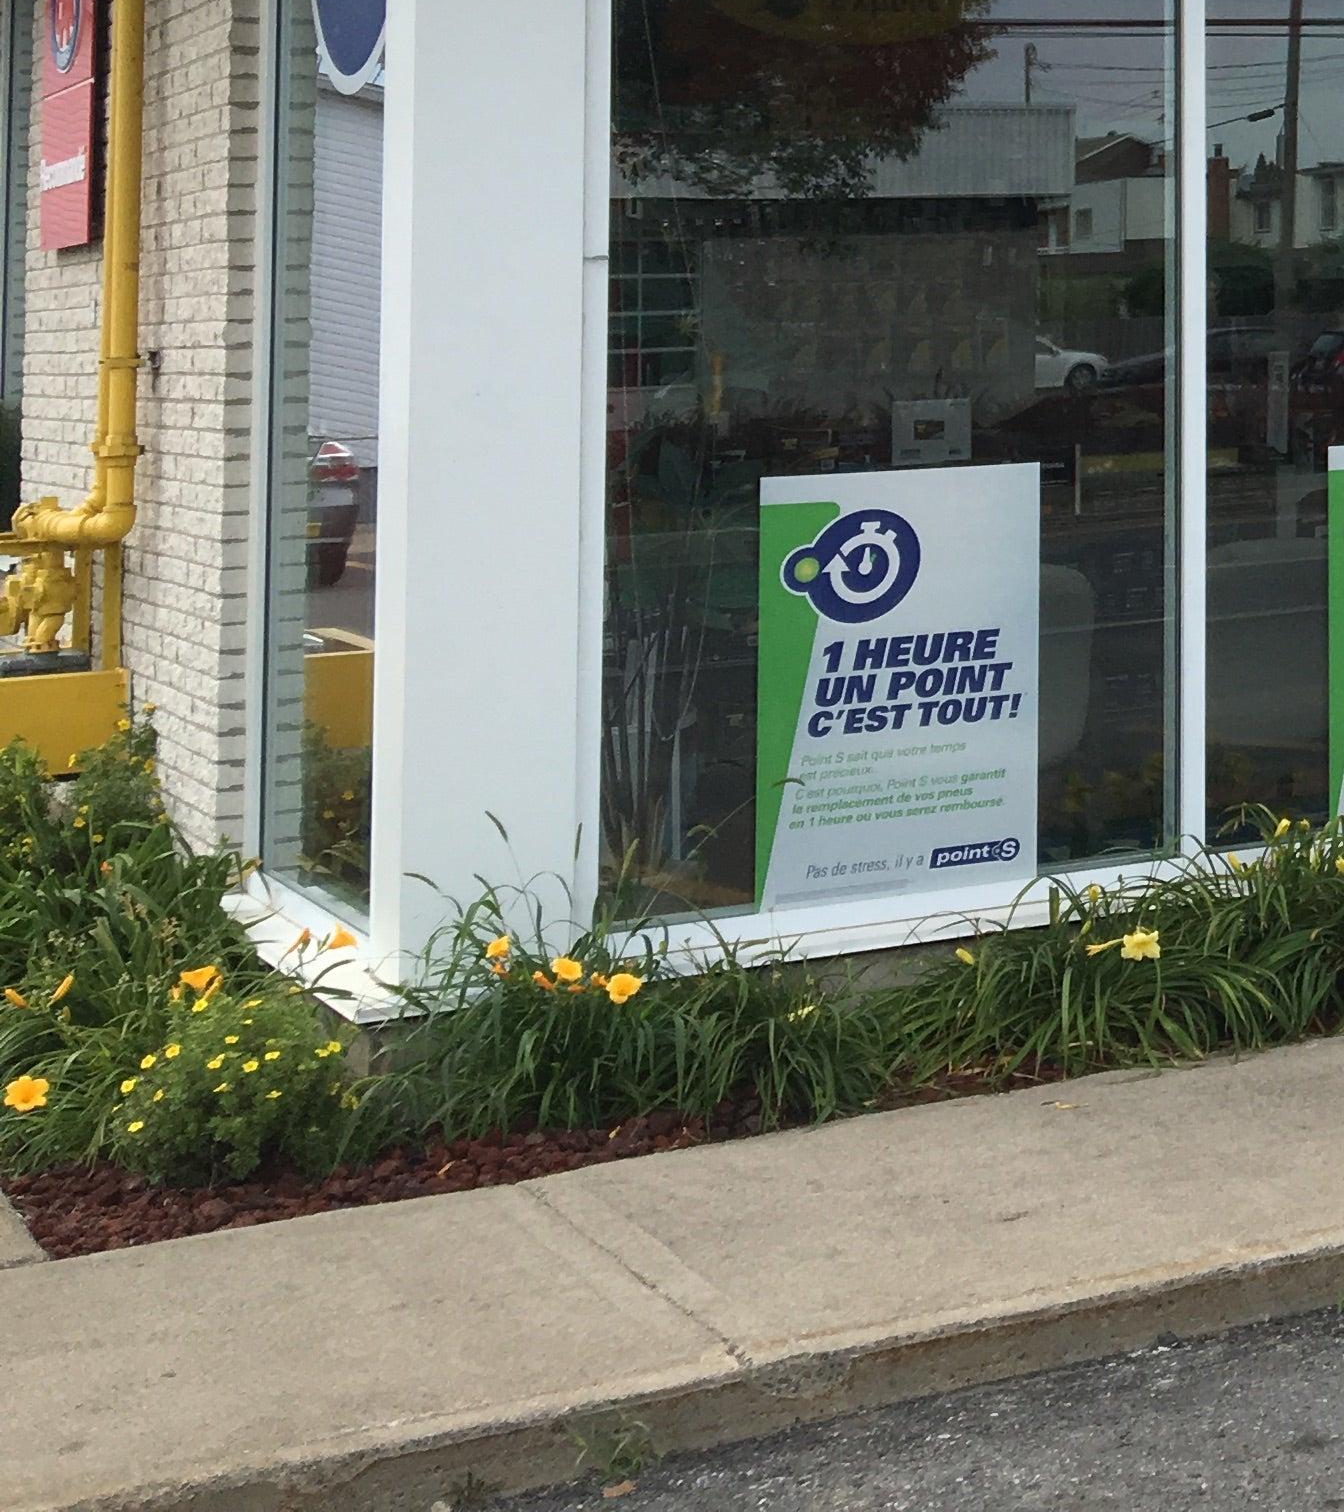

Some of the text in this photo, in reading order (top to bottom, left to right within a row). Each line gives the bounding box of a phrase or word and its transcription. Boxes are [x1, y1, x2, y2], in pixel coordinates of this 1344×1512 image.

[822, 628, 1000, 673] 1 HEURE
[814, 662, 1012, 709] UN POINT
[807, 693, 1023, 739] C'EST TOUT!
[801, 754, 832, 766] Point
[835, 752, 844, 764] S
[871, 749, 893, 760] que
[930, 742, 966, 755] temps
[887, 778, 916, 790] Point
[918, 776, 928, 787] S
[931, 774, 959, 785] vous
[961, 768, 1007, 784] garantit
[792, 786, 973, 814] le remplacement de vos pneus
[788, 819, 805, 829] en
[819, 814, 853, 826] heure
[874, 808, 903, 820] vous
[806, 864, 827, 879] Pas
[831, 862, 847, 876] de
[851, 858, 890, 874] stress,
[936, 845, 990, 866] point
